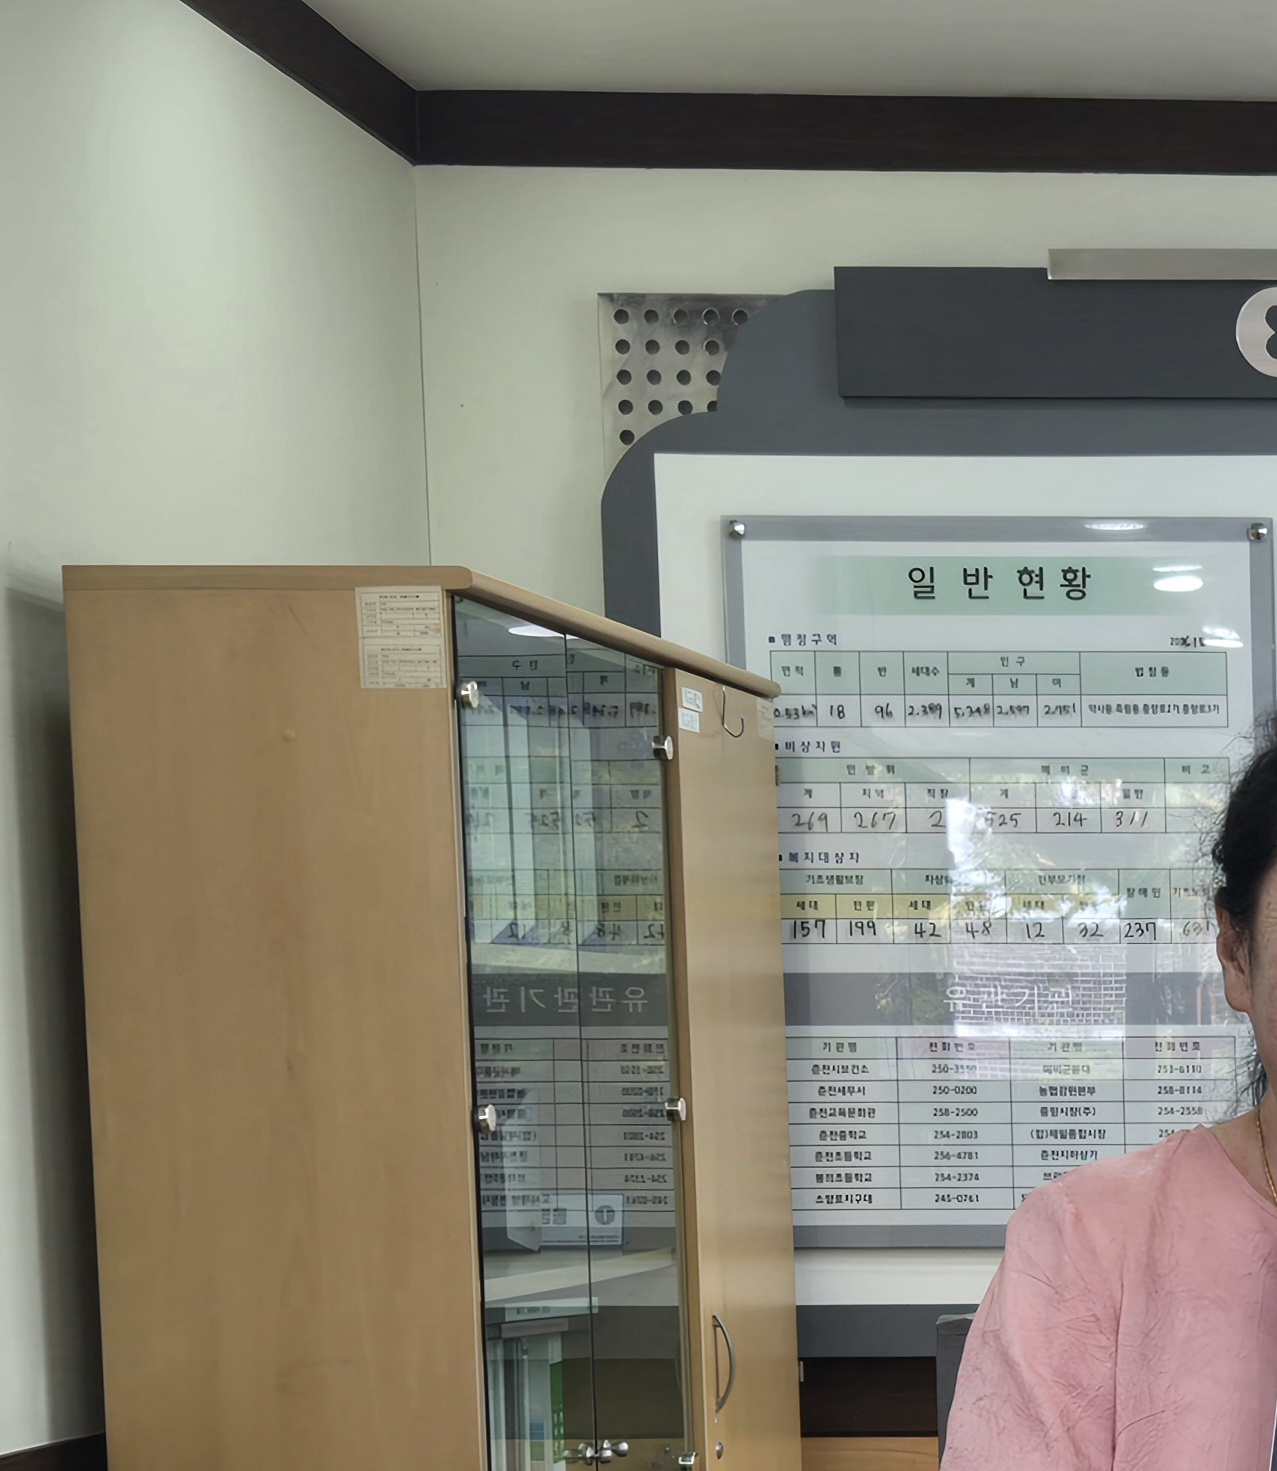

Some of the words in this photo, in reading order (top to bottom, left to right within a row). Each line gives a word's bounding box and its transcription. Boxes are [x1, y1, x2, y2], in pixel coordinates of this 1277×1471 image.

[829, 704, 846, 719] 18
[875, 703, 894, 719] 96
[791, 811, 829, 833] 269
[853, 811, 897, 831] 267
[1053, 811, 1088, 827] 214
[792, 919, 827, 940] 157
[849, 919, 878, 937] 199
[914, 922, 942, 939] 42
[965, 921, 992, 940] 48
[1025, 921, 1046, 940] 12
[1078, 921, 1104, 938] 32
[1124, 921, 1157, 941] 237
